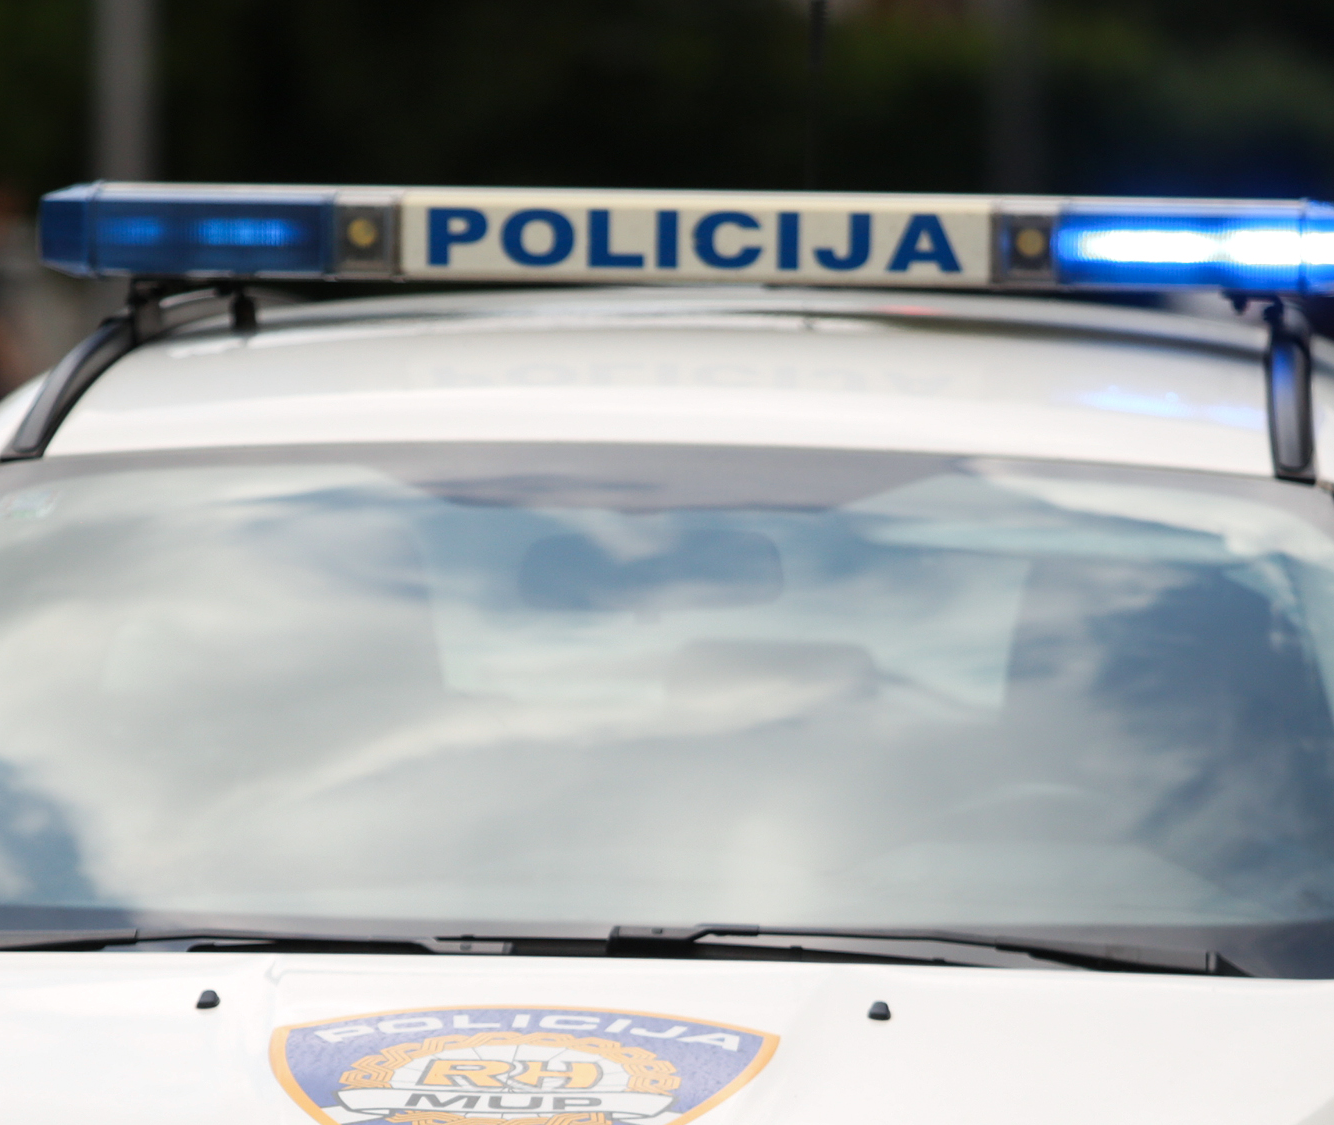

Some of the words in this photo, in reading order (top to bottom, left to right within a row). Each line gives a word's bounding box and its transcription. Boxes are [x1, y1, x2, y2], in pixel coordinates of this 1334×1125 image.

[426, 208, 962, 273] POLICIJA
[315, 1012, 743, 1052] POLICIJA
[417, 1058, 605, 1091] RH
[405, 1093, 603, 1113] MUP
